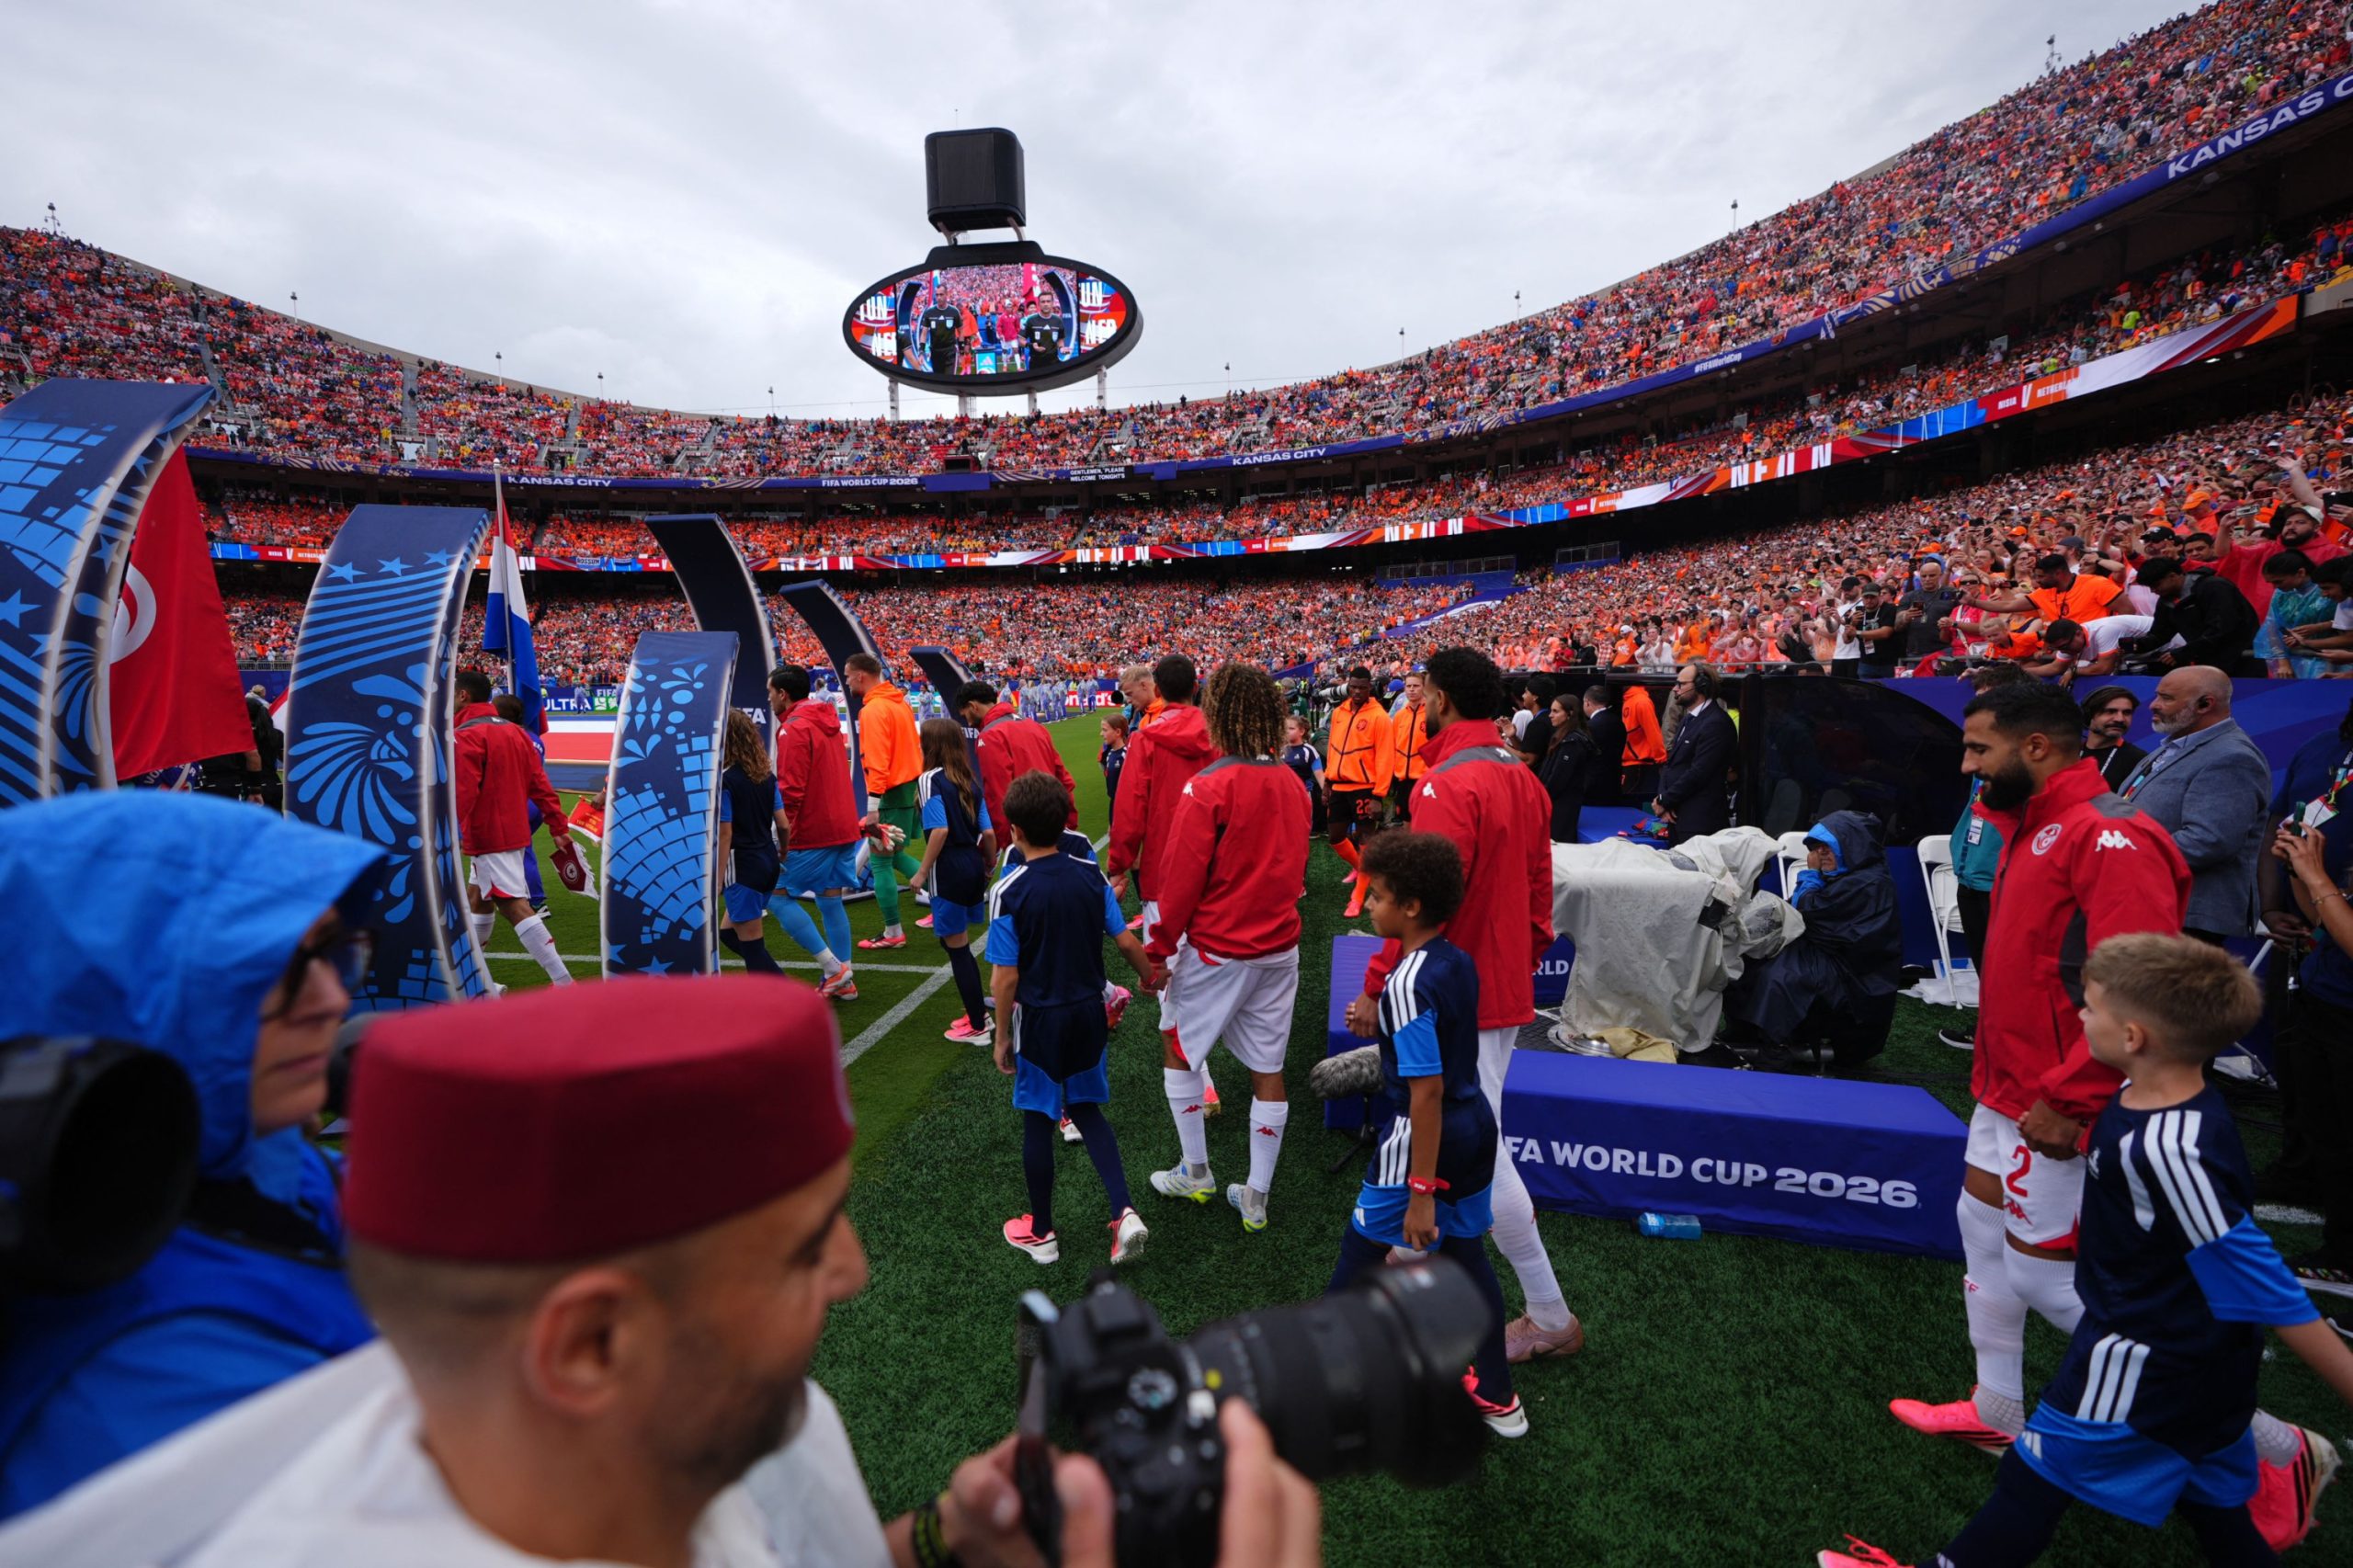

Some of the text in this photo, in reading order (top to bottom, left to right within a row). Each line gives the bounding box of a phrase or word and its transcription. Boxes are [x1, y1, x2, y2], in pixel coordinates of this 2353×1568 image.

[2168, 91, 2325, 179] KANSAS
[1694, 352, 1743, 374] #FIFAWorldCup
[1233, 448, 1326, 465] KANSAS CITY
[507, 476, 612, 488] KANSAS CITY
[822, 477, 919, 487] FIFA WORLD CUP 2026
[1505, 1136, 1918, 1210] FA WORLD CUP 2026
[2005, 1144, 2032, 1198] 2
